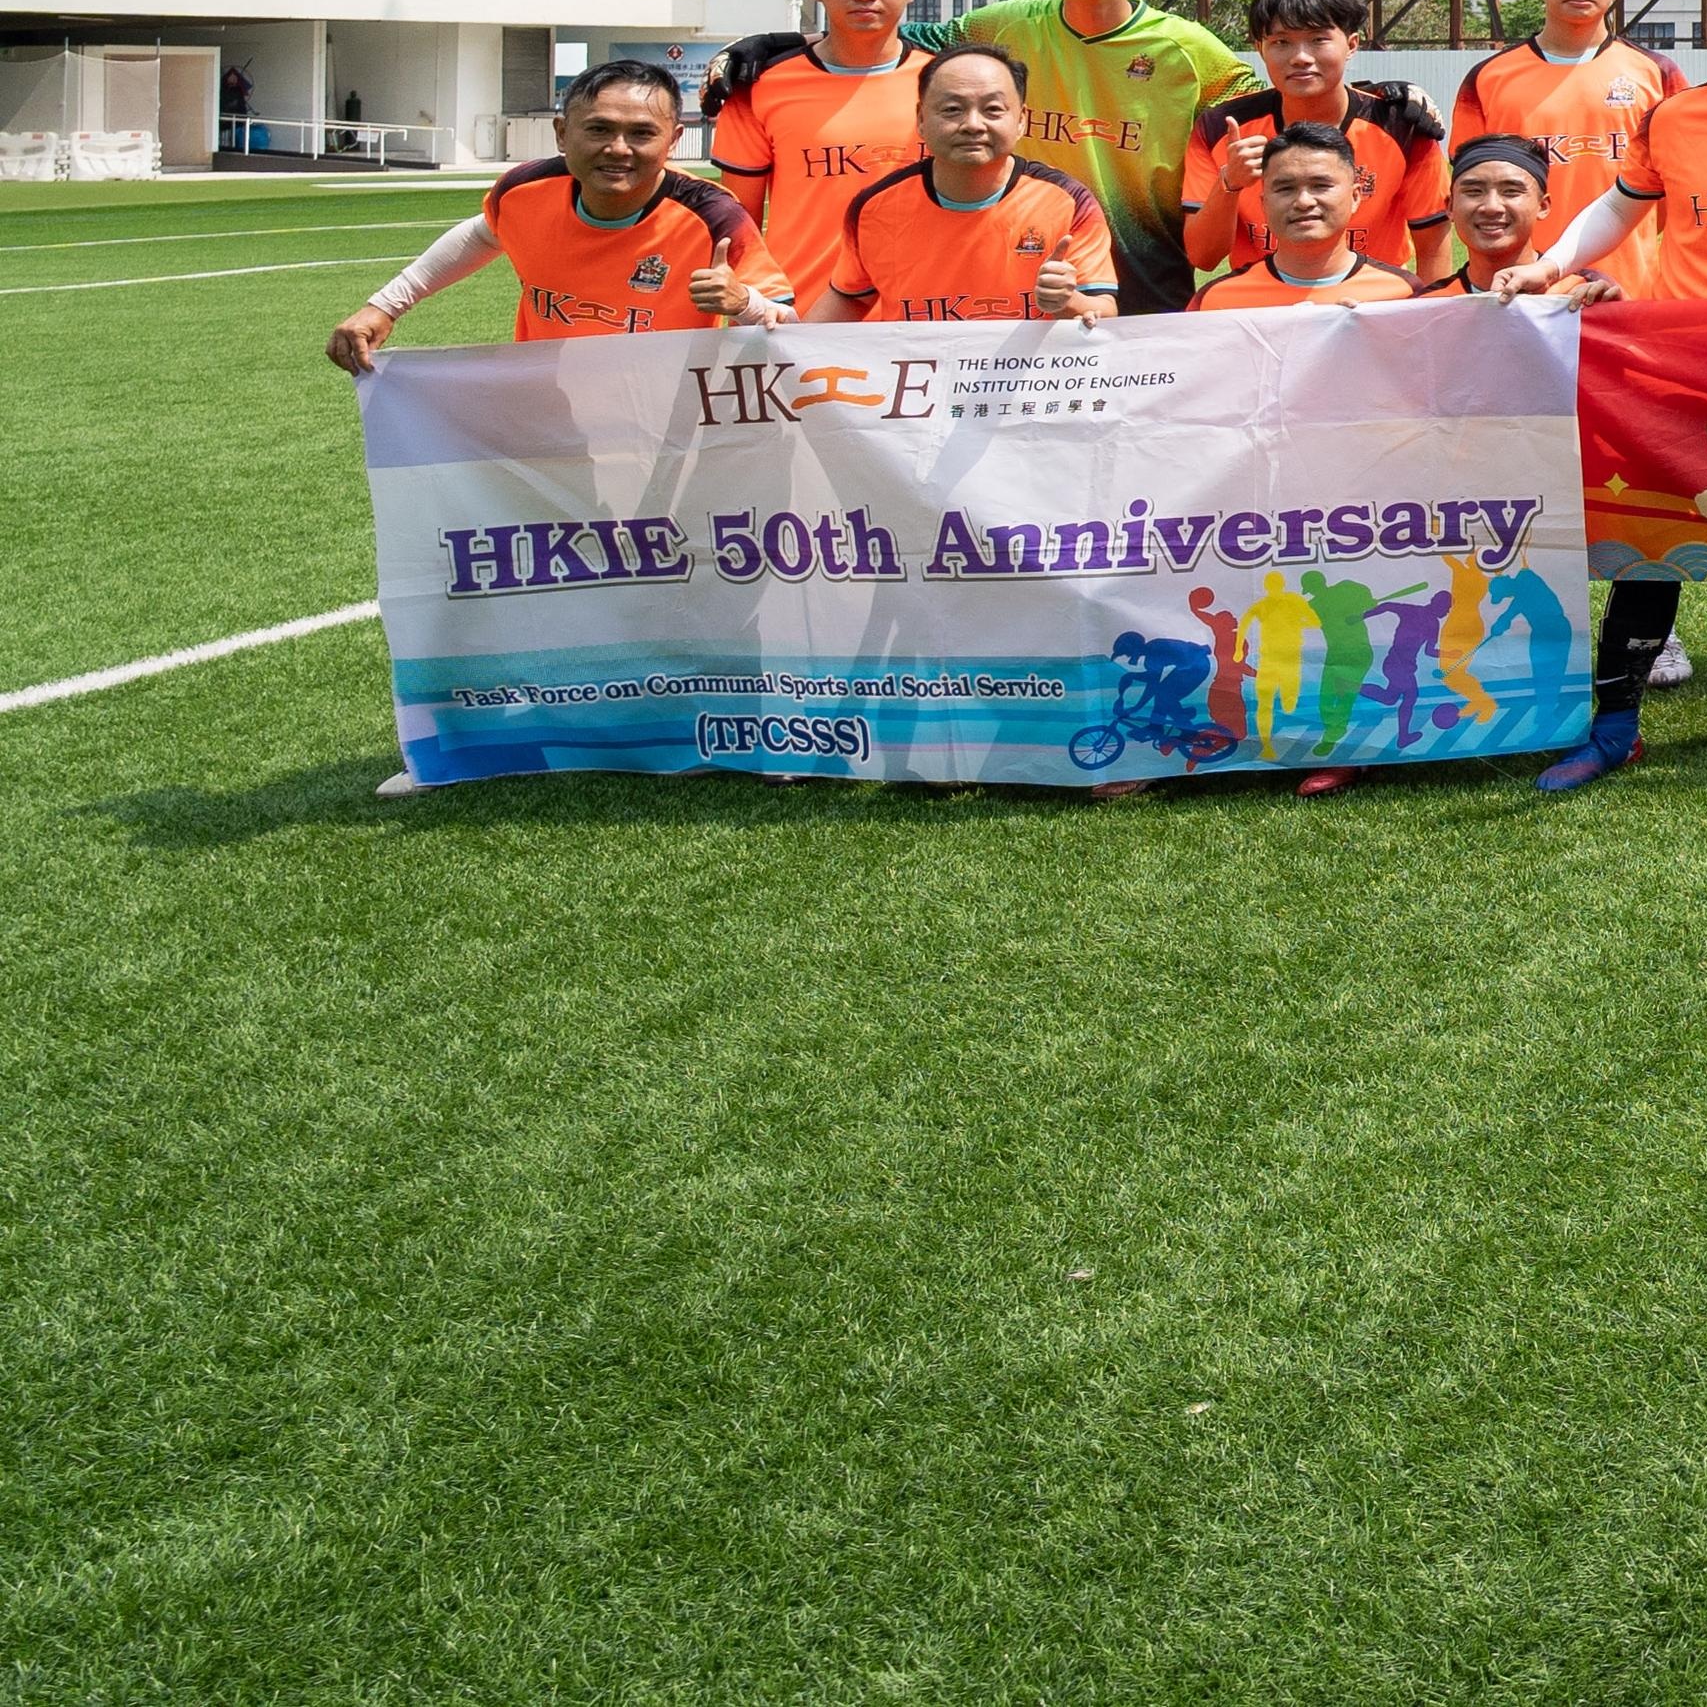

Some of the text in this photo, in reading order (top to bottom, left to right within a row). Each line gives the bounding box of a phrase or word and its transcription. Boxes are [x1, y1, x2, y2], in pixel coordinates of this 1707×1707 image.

[957, 355, 1099, 371] THE HONG KONG
[953, 372, 1176, 395] INSTITUTION OF ENGINEERS
[949, 398, 1108, 419] 香港工程師學會
[442, 496, 1541, 595] HKIE 50th Anniversary
[455, 673, 1064, 708] Task Force on Communal Sports and Social Service
[697, 711, 871, 762] (TFCSSS)
